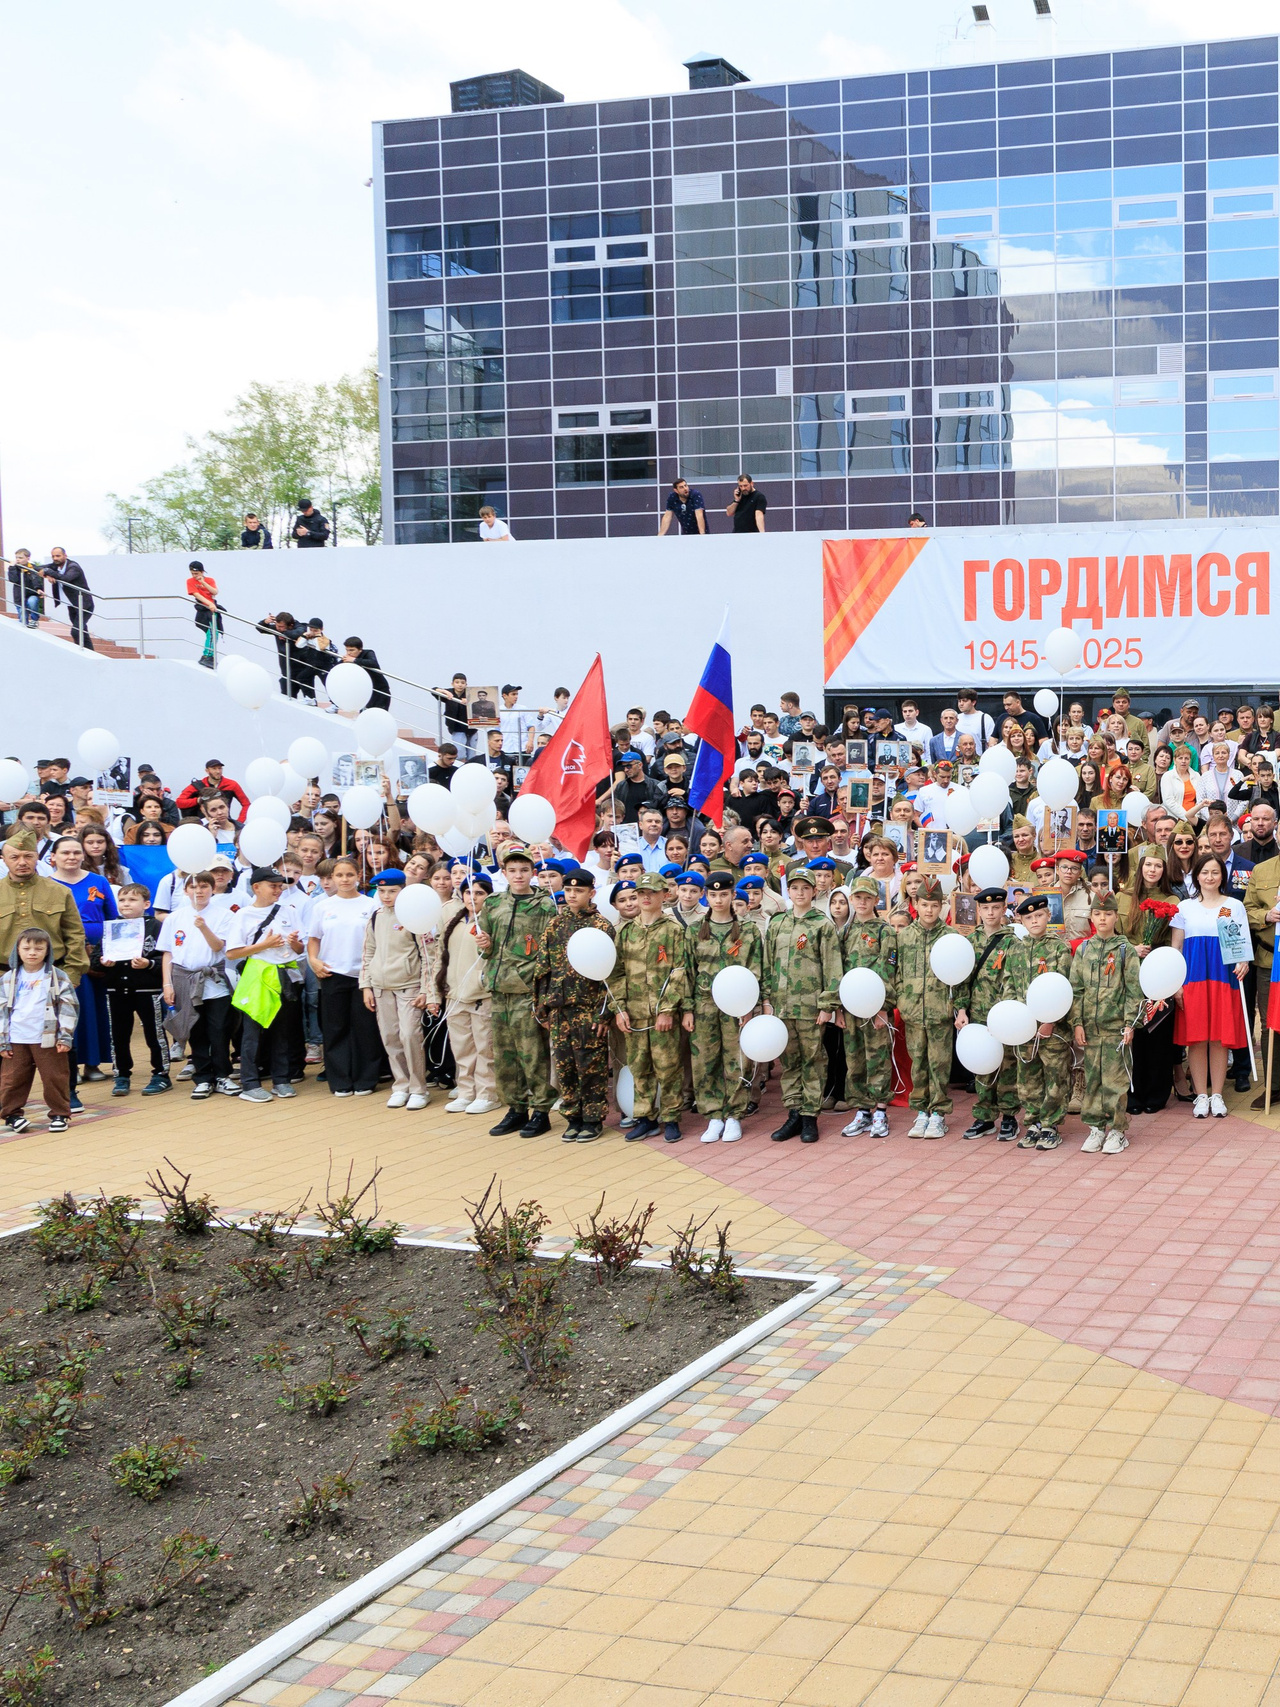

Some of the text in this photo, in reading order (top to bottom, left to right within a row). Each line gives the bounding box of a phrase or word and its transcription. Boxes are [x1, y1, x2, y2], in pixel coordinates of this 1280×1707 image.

[963, 551, 1270, 630] ГОРДИМСЯ
[964, 637, 1143, 671] 1945-025
[641, 876, 651, 884] Z
